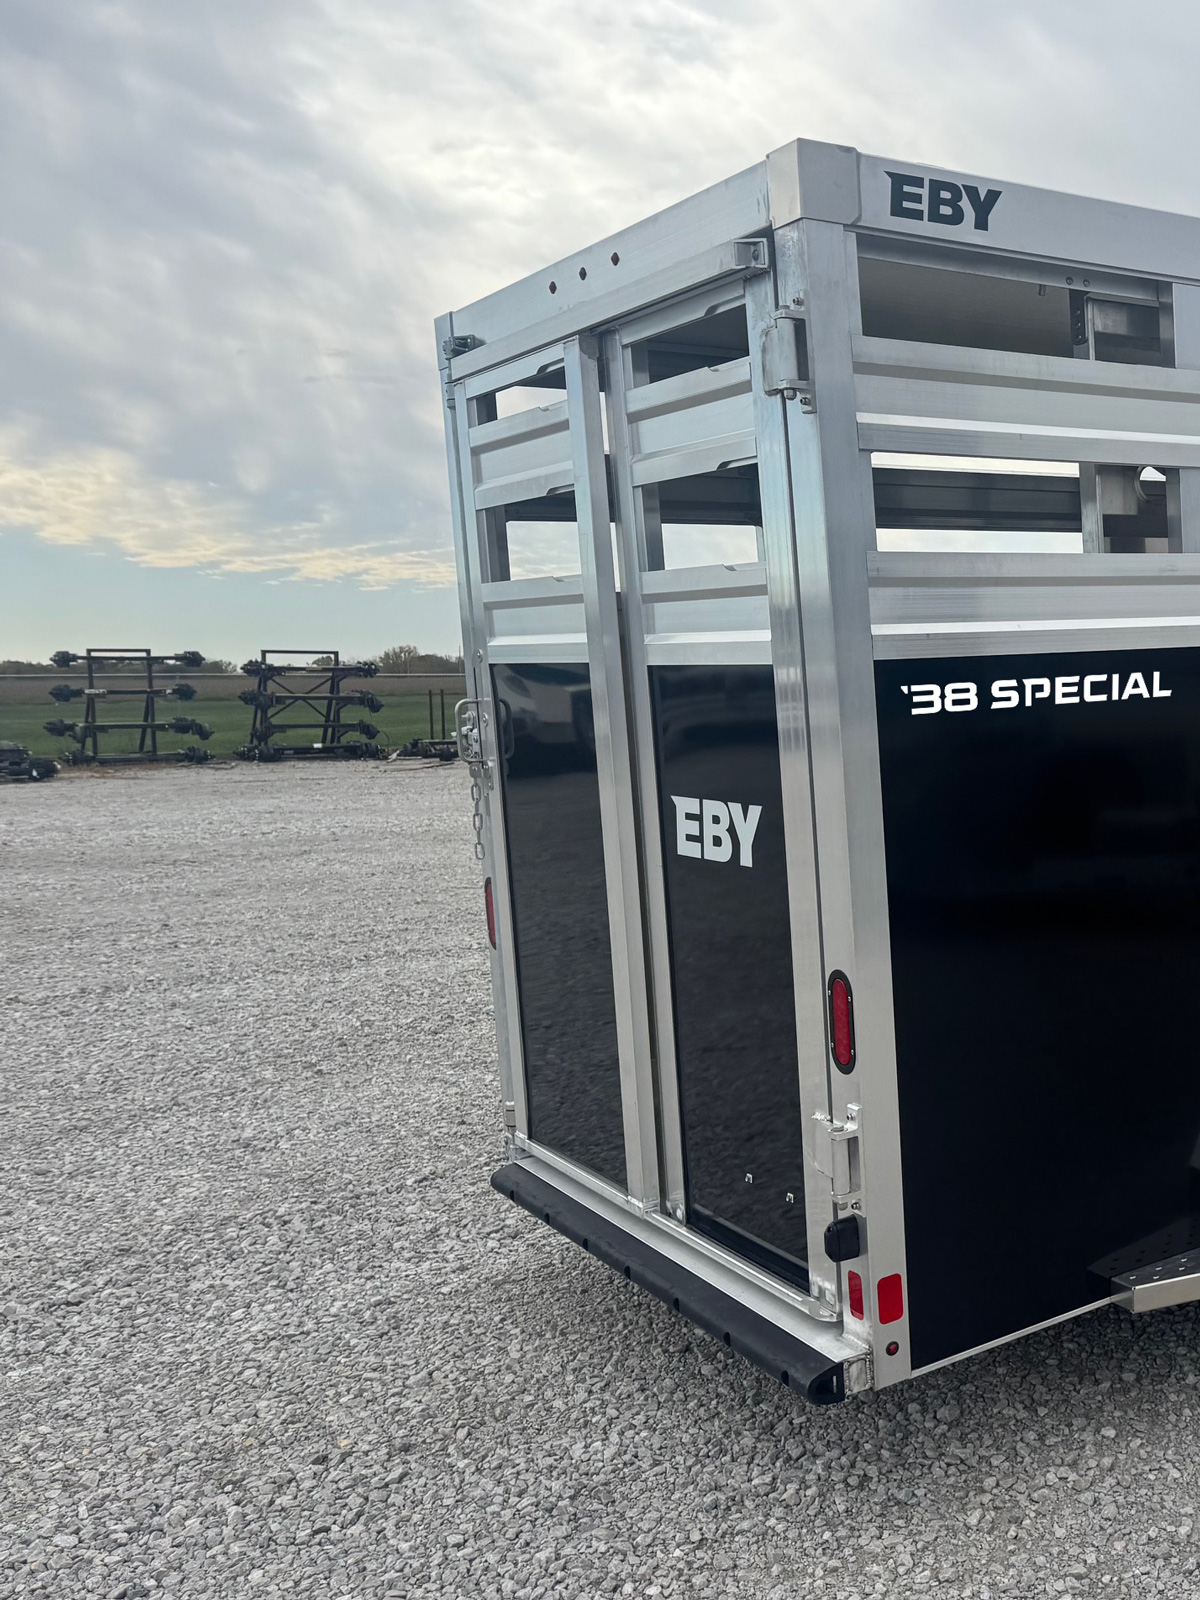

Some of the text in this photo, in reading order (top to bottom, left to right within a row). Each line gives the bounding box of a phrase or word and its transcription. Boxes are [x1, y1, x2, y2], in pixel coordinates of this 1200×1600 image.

[884, 170, 1003, 232] EBY
[990, 671, 1172, 709] SPECIAL
[670, 795, 763, 868] EBY
